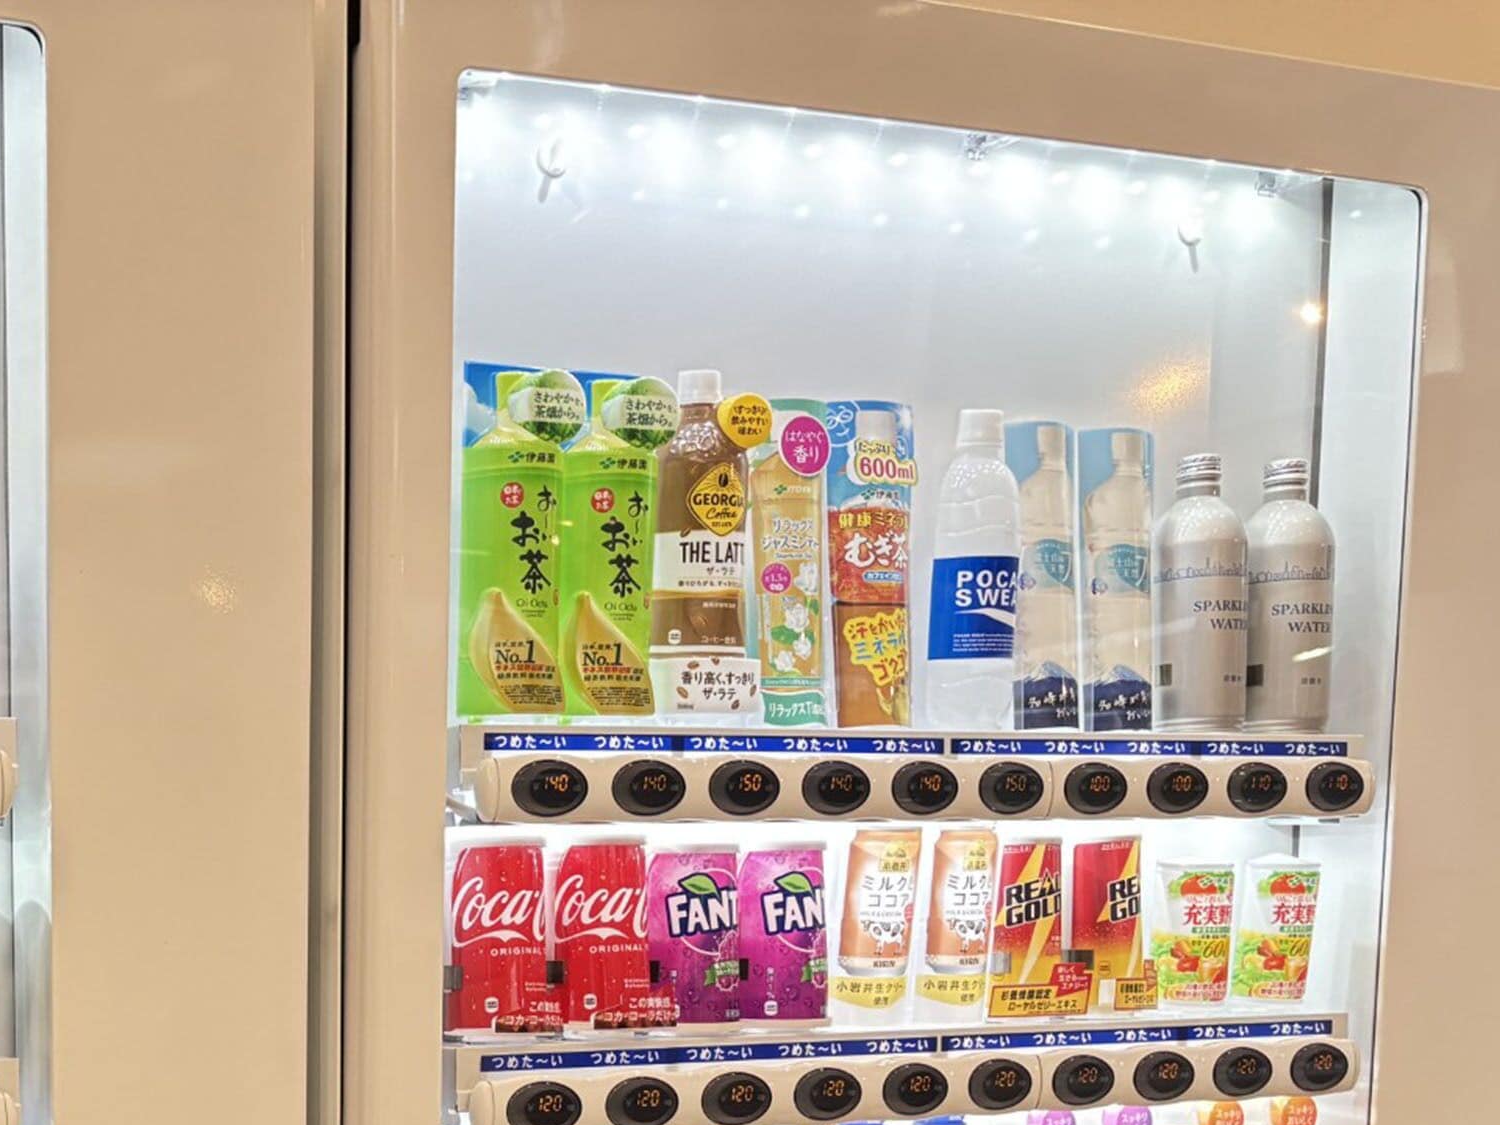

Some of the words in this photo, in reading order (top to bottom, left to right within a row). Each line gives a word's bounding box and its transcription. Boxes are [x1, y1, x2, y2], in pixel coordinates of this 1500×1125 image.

[860, 457, 914, 479] 600ml
[679, 541, 711, 563] THE
[495, 640, 536, 665] No.1
[582, 643, 623, 666] No.1
